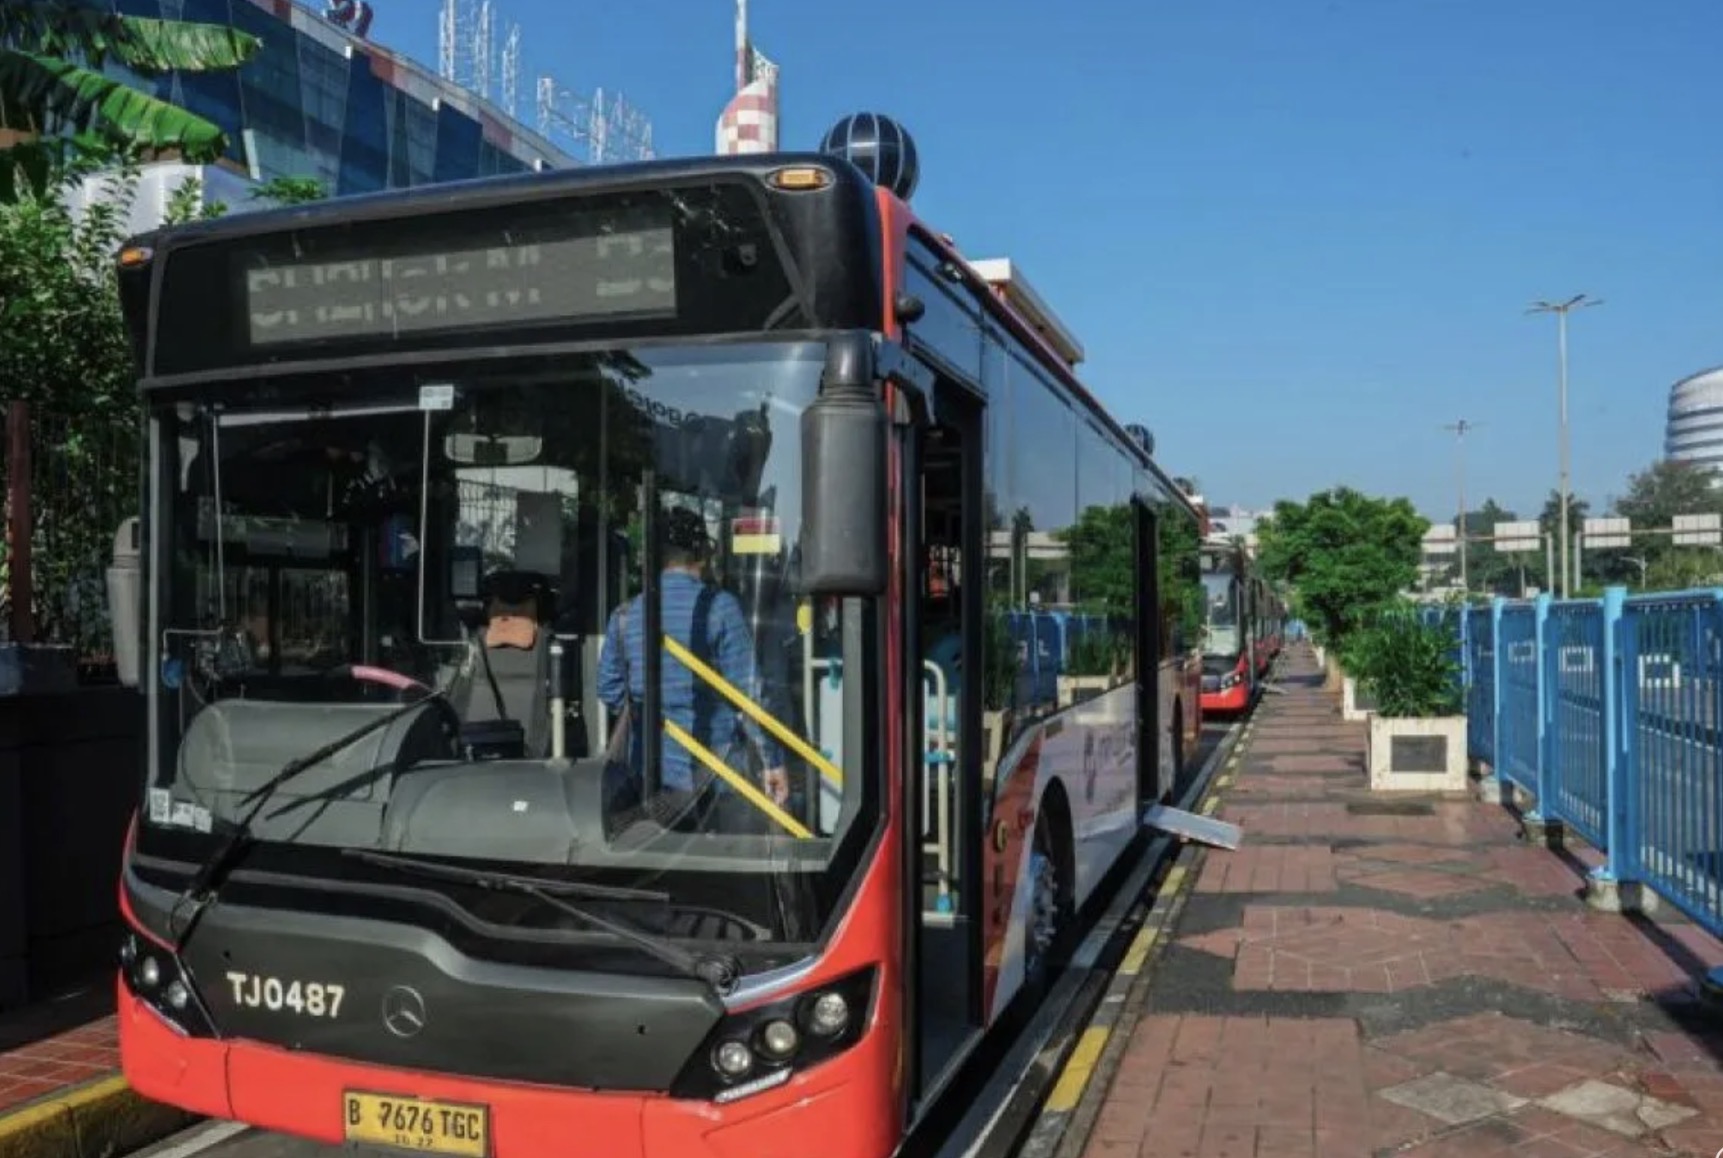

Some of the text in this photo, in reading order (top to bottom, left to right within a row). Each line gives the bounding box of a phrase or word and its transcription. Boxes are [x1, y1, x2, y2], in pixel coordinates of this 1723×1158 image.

[226, 971, 344, 1018] TJ0487
[349, 1100, 479, 1140] B 7676 TGC
